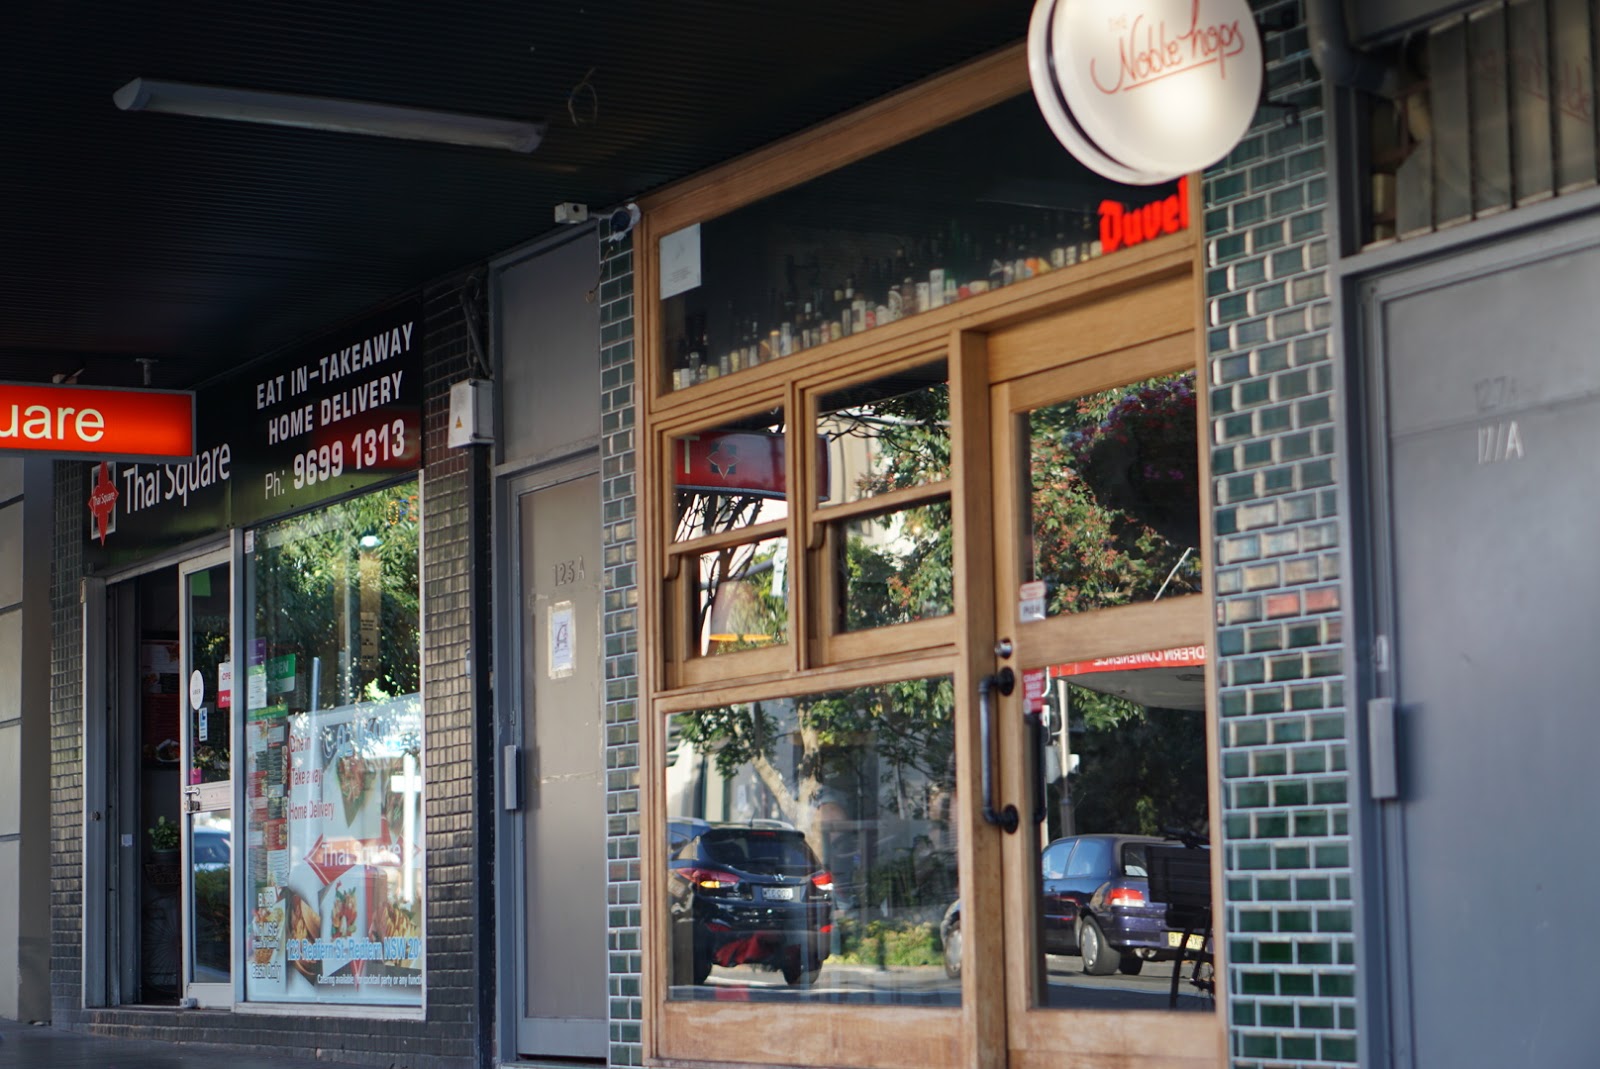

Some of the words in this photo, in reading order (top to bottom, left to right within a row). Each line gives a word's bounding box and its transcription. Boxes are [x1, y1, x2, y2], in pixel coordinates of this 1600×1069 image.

[1090, 14, 1182, 94] Noble
[1177, 0, 1245, 80] hops
[1097, 174, 1189, 254] Duvel
[256, 374, 285, 410] EAT
[268, 404, 313, 446] HOME
[320, 370, 403, 427] DELIVERY
[0, 404, 105, 443] uare
[293, 440, 344, 490] 9699
[351, 418, 405, 470] 1313
[123, 463, 160, 514] Thai
[164, 443, 231, 507] Square
[290, 802, 308, 820] Home
[309, 799, 335, 821] Delivery
[321, 842, 350, 867] Thai
[302, 938, 335, 960] Redfern
[348, 937, 382, 960] Redfern
[384, 936, 407, 960] NSW
[380, 974, 392, 987] party
[393, 976, 399, 985] or
[399, 976, 408, 987] any
